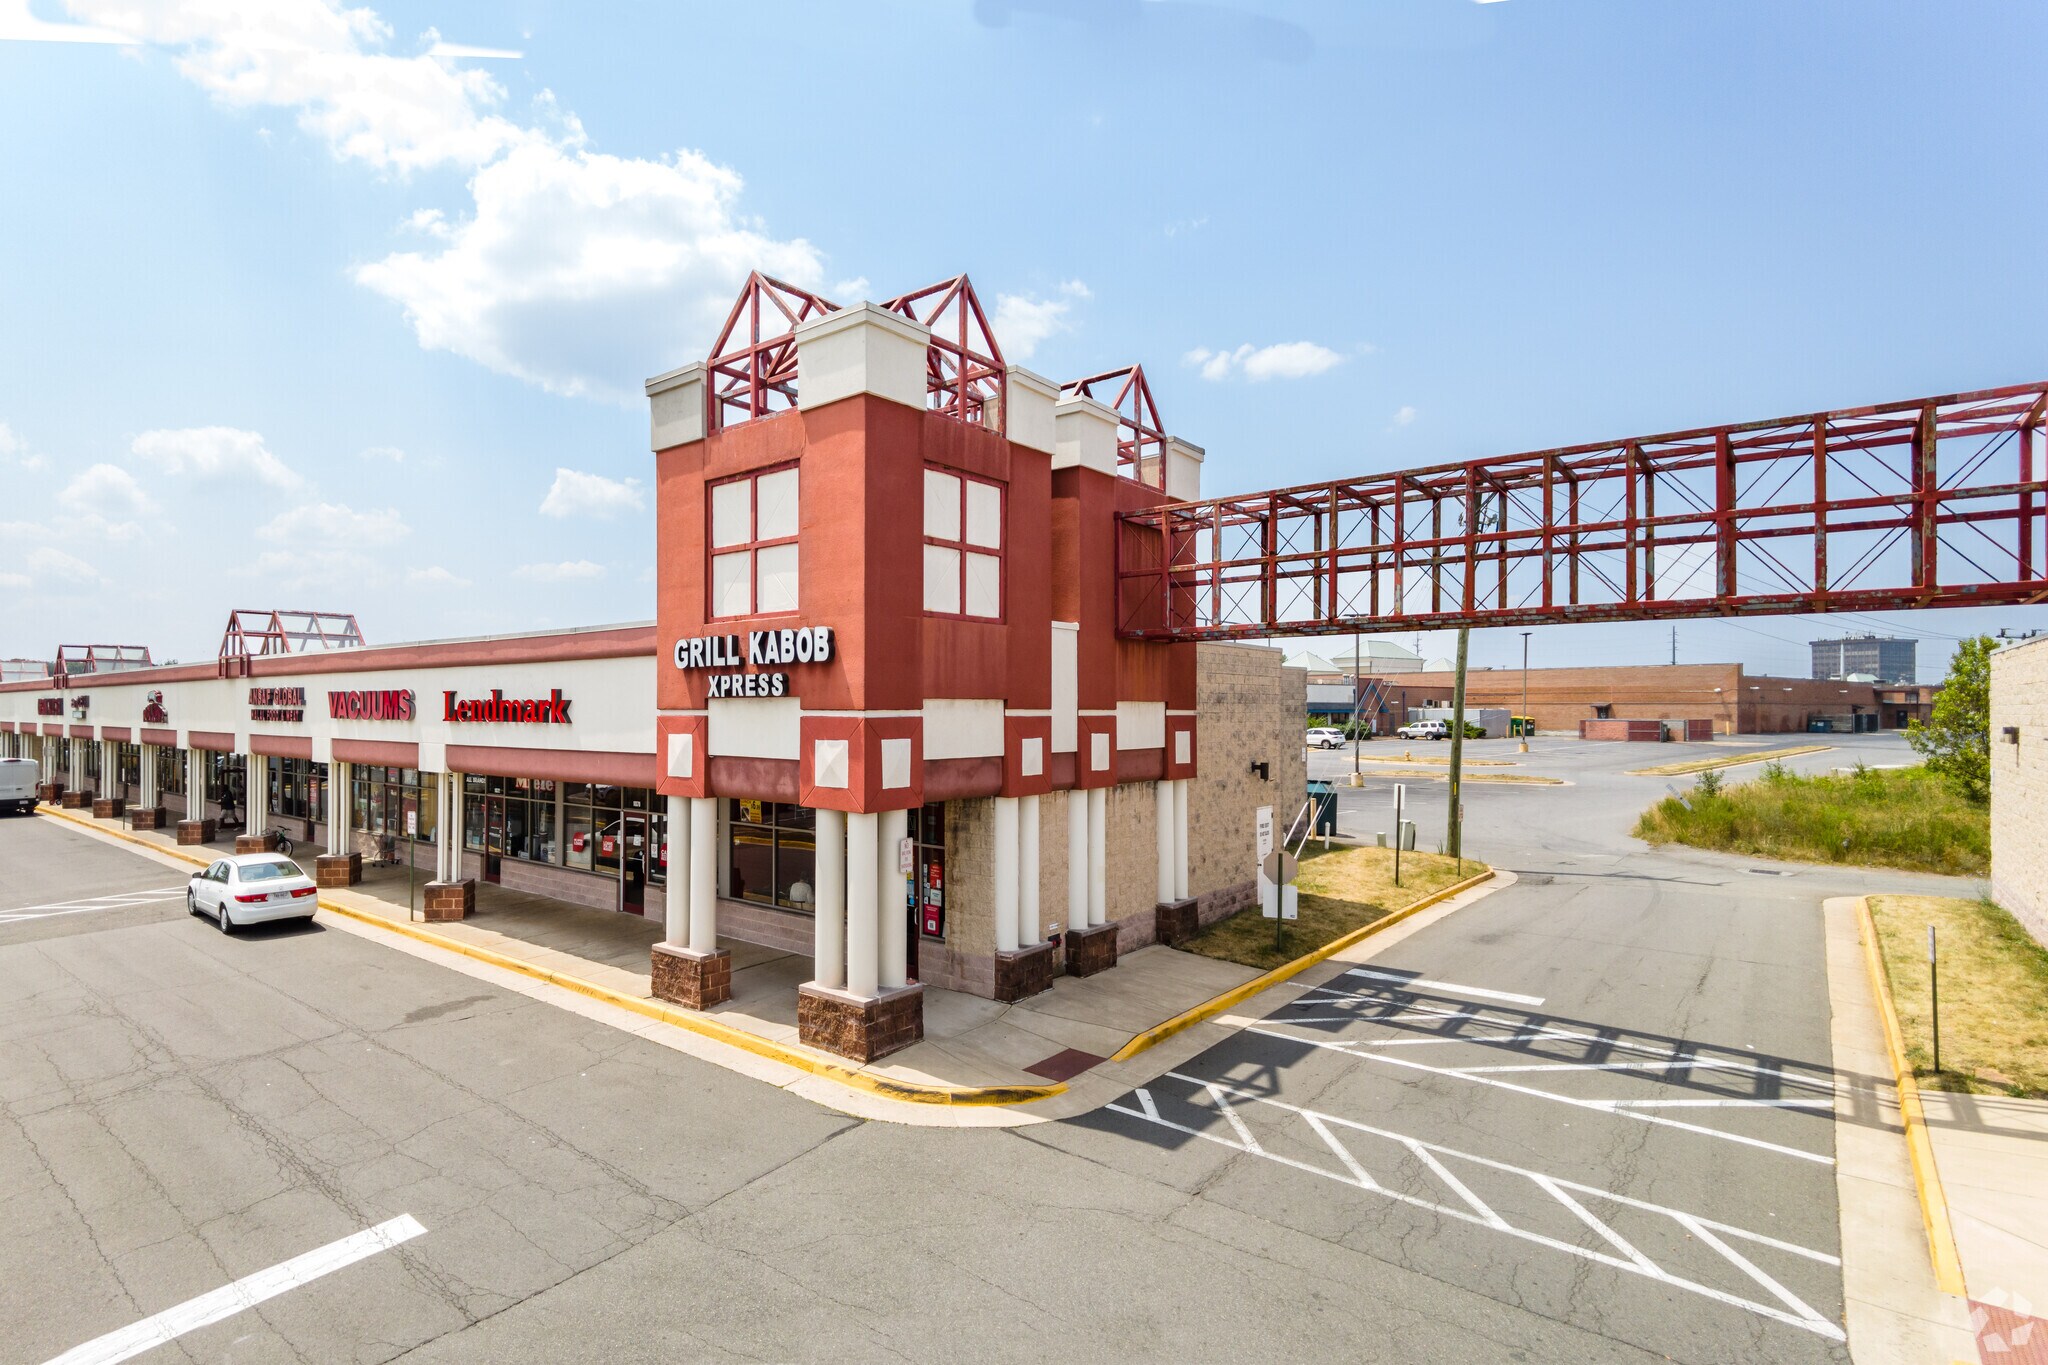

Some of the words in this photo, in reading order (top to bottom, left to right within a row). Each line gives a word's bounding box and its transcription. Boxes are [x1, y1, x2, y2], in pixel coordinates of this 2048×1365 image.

[674, 634, 742, 669] GRILL
[749, 626, 833, 665] KABOB
[249, 688, 272, 706] ANSAF
[273, 687, 304, 706] GLOBAL
[708, 672, 786, 698] XPRESS
[328, 689, 415, 721] VACUUMS
[443, 689, 571, 723] Lendmark
